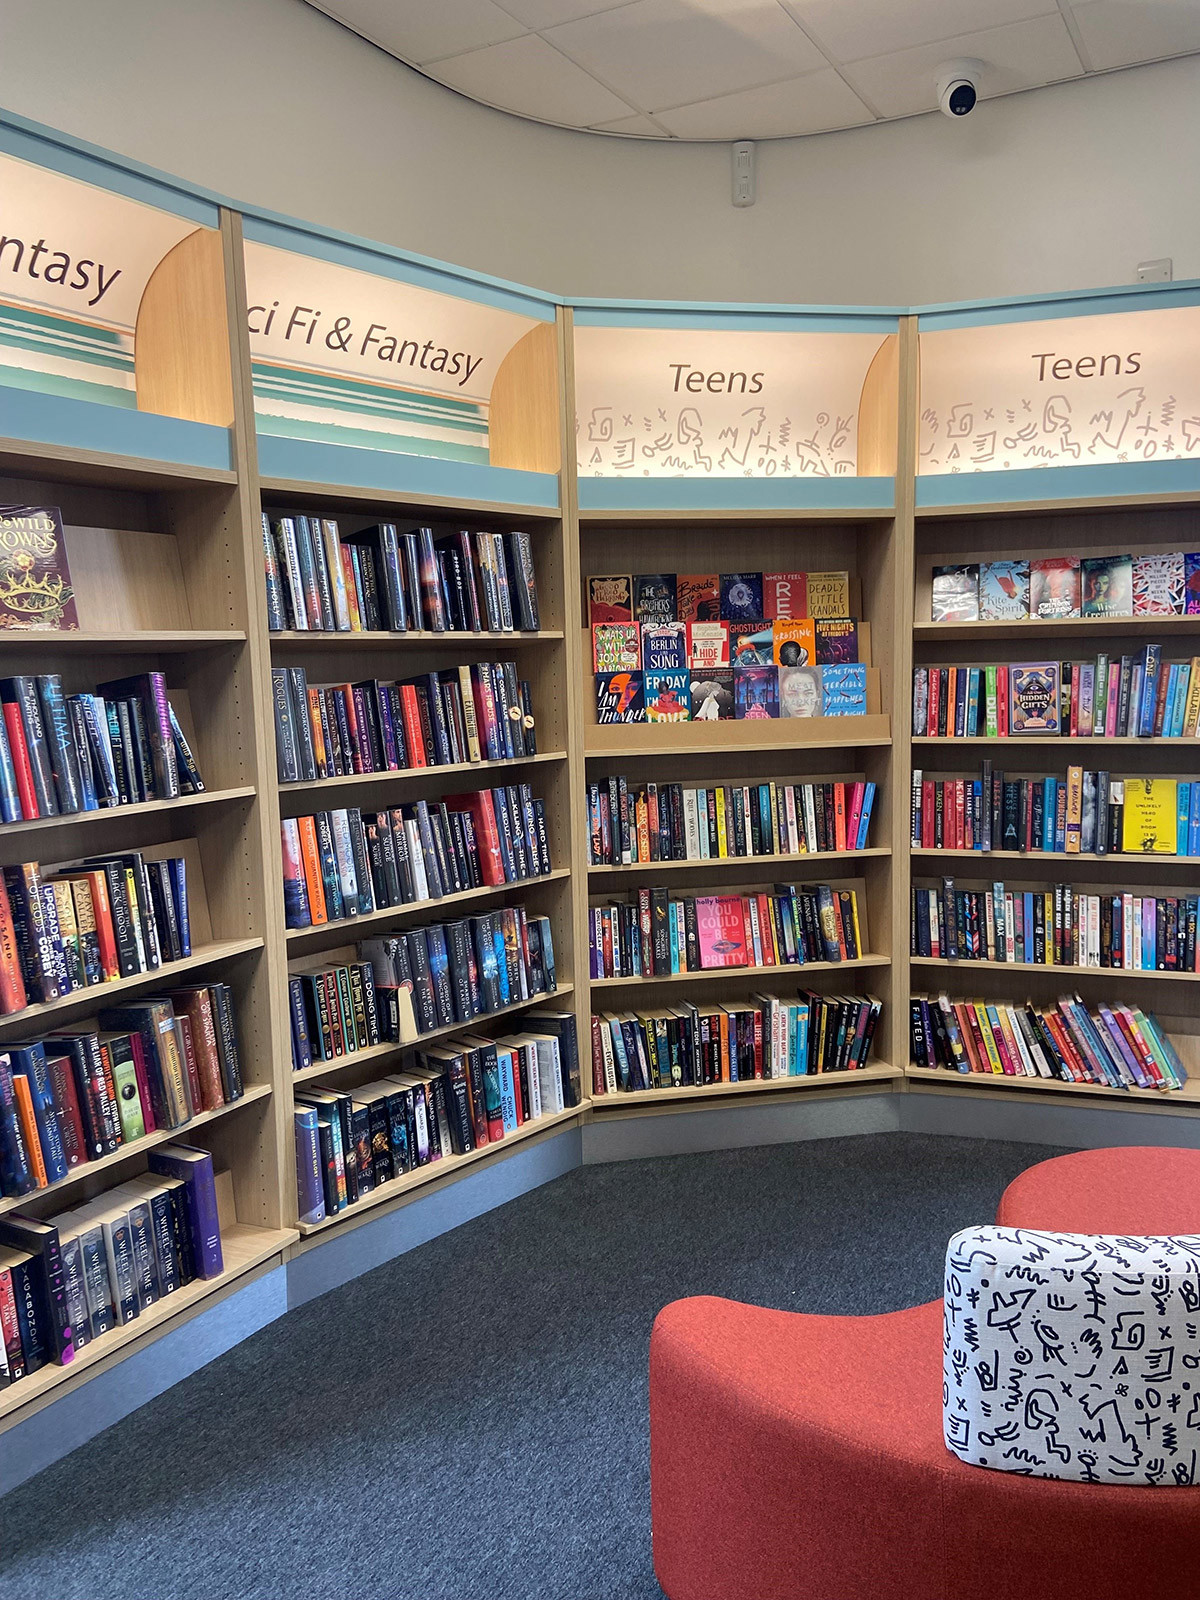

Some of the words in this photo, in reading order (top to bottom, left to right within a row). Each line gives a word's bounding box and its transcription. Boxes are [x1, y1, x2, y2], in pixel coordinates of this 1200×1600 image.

[285, 306, 321, 344] Fi
[325, 316, 353, 352] &
[360, 324, 483, 386] Fantasy
[668, 363, 765, 395] Teens
[1031, 350, 1142, 383] Teens
[809, 583, 845, 593] DEADLY
[501, 806, 510, 837] ABOUT
[526, 802, 535, 834] SAVING
[538, 817, 546, 842] HARD
[44, 888, 60, 941] UPGRADE
[39, 936, 53, 978] COREY
[366, 982, 375, 1014] DOING
[501, 1060, 509, 1092] WAYWARD
[160, 1215, 170, 1249] WHEEL
[164, 1252, 174, 1278] TIME
